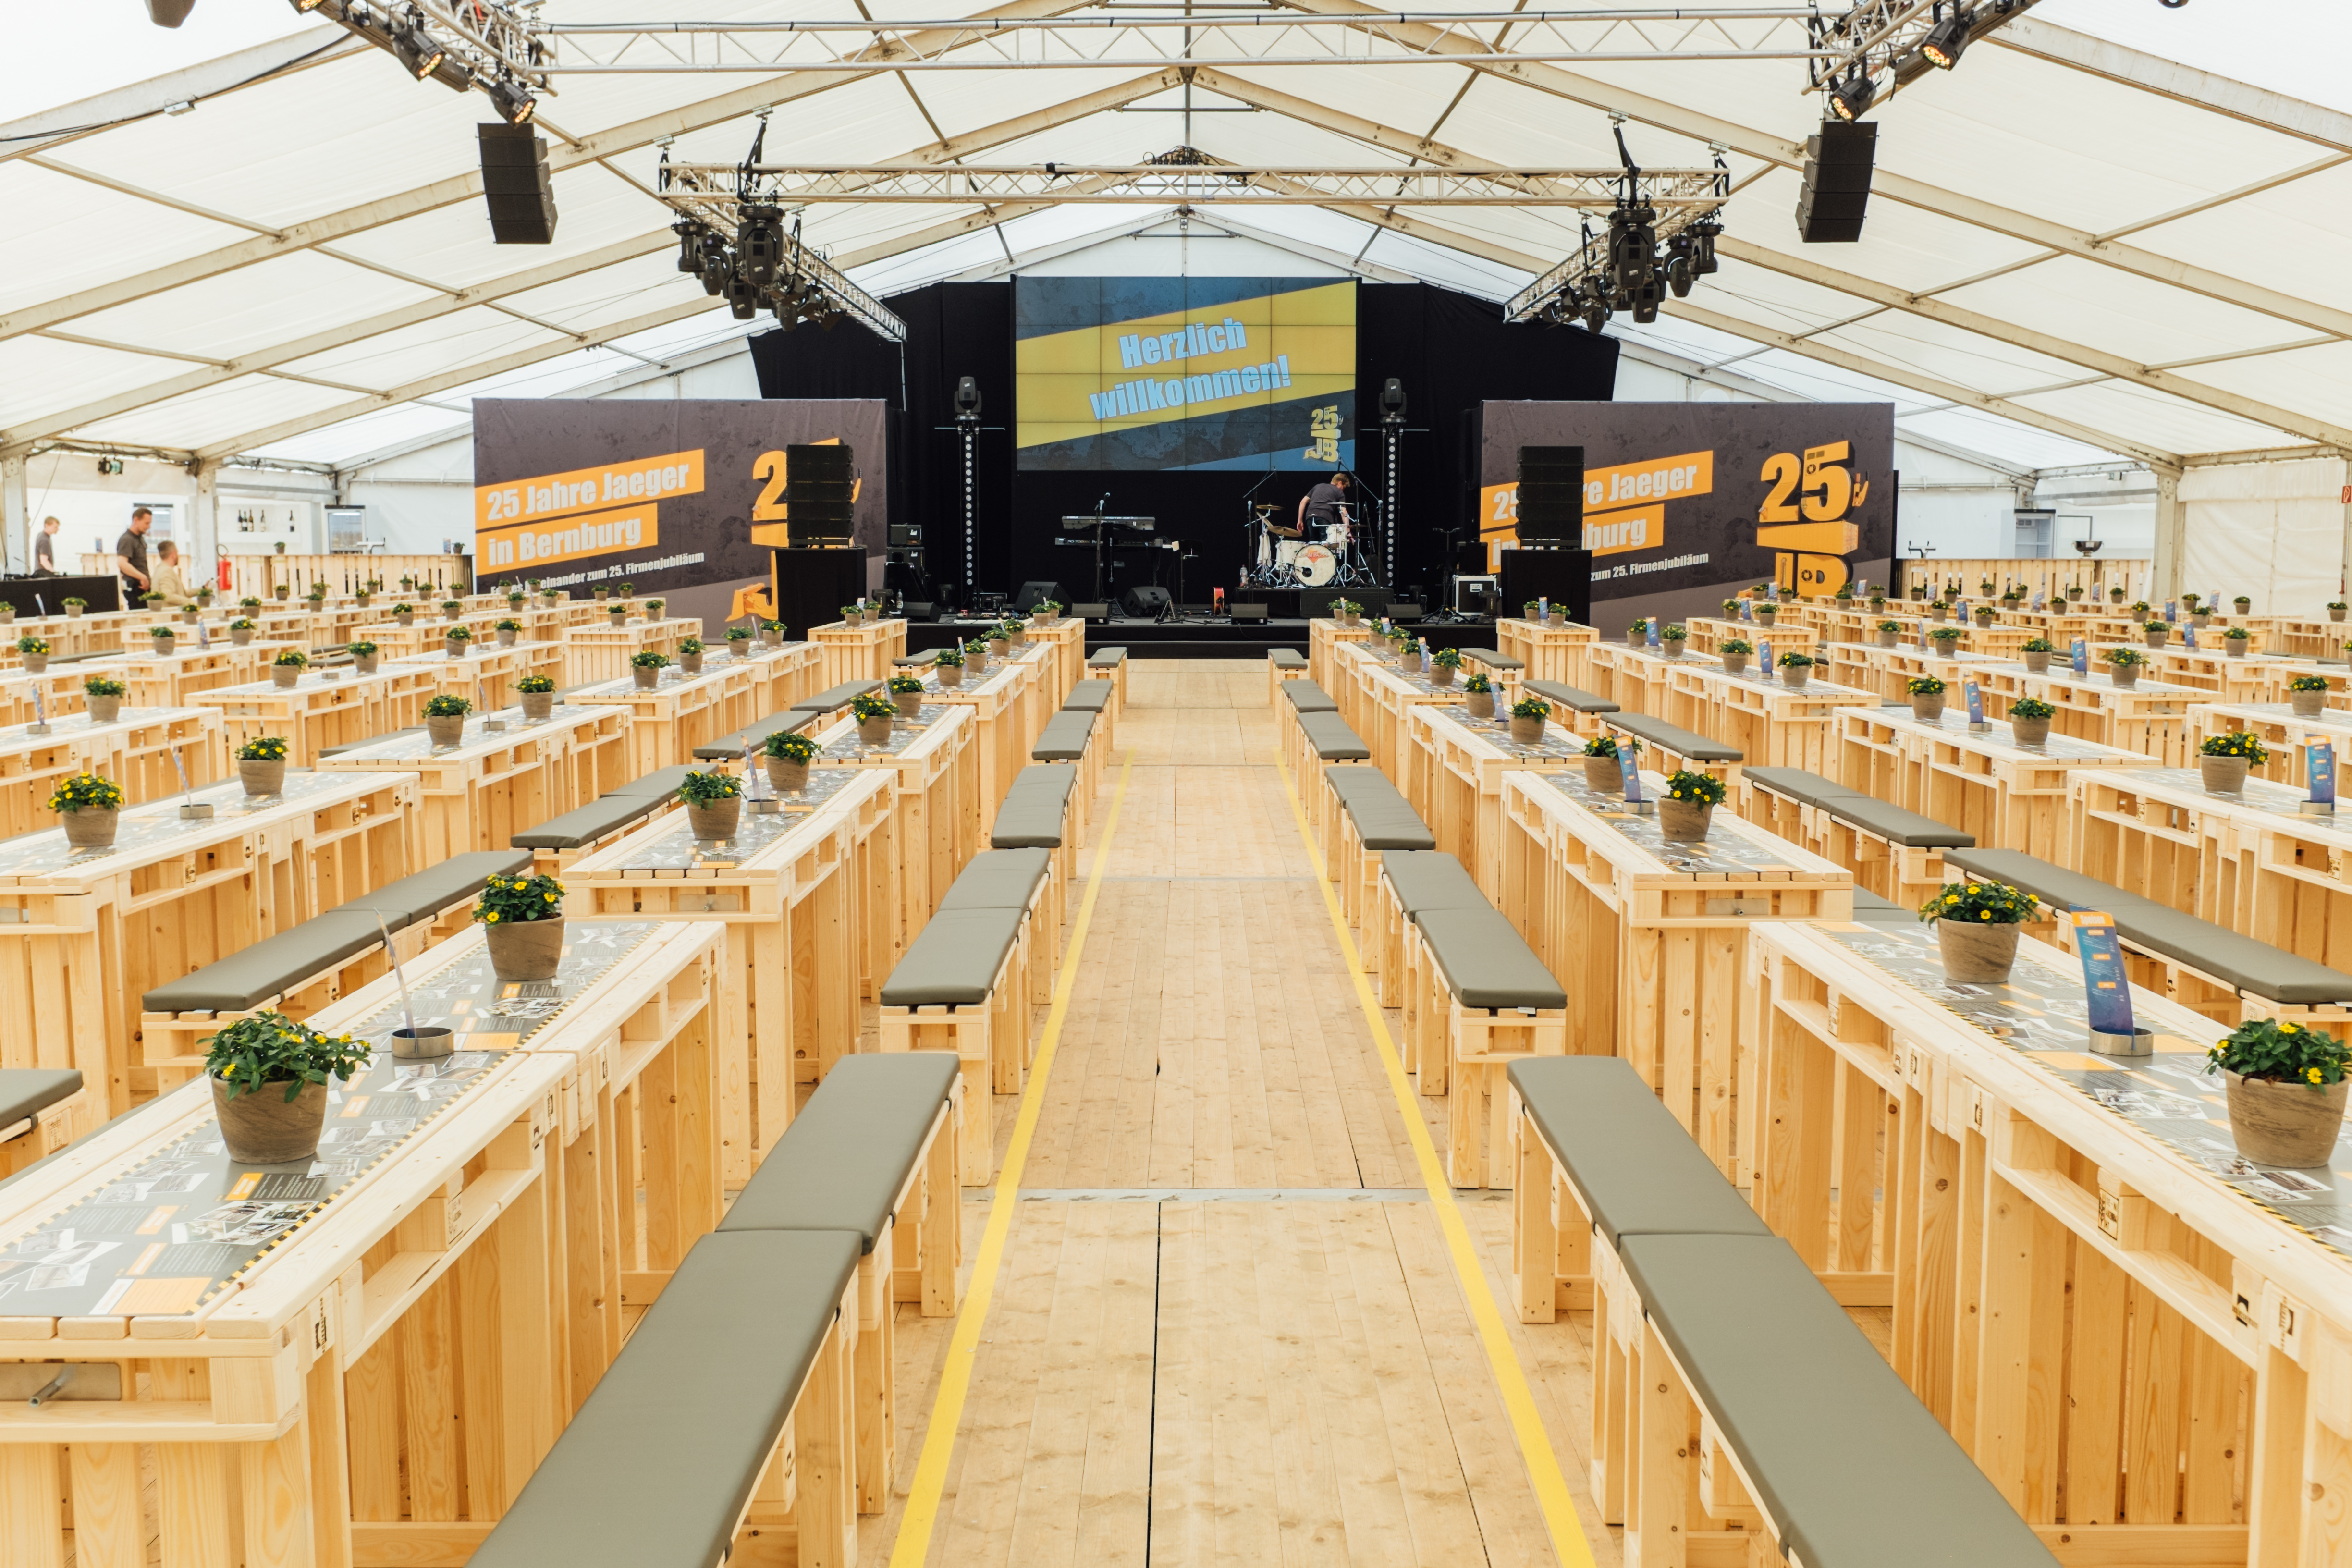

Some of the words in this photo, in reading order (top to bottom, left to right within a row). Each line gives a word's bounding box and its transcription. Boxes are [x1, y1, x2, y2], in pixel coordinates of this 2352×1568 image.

[1118, 317, 1247, 369] Herzlich
[1089, 355, 1291, 420] willkommen!
[1311, 405, 1338, 430] 25
[487, 488, 520, 521] 25
[525, 479, 597, 515] Jahre
[601, 463, 690, 502] Jaeger
[1608, 464, 1697, 502] Jaeger
[1759, 440, 1853, 523] 25
[488, 538, 514, 567] in
[519, 517, 641, 562] Bernburg
[490, 584, 524, 593] Fees
[587, 568, 608, 581] zum
[609, 564, 625, 578] 25.
[625, 552, 705, 575] Firmenjubiläum
[1591, 569, 1611, 582] zum
[1613, 564, 1628, 578] 25.
[1629, 553, 1709, 576] Firmenjubiläum
[2080, 914, 2106, 925] Speisen
